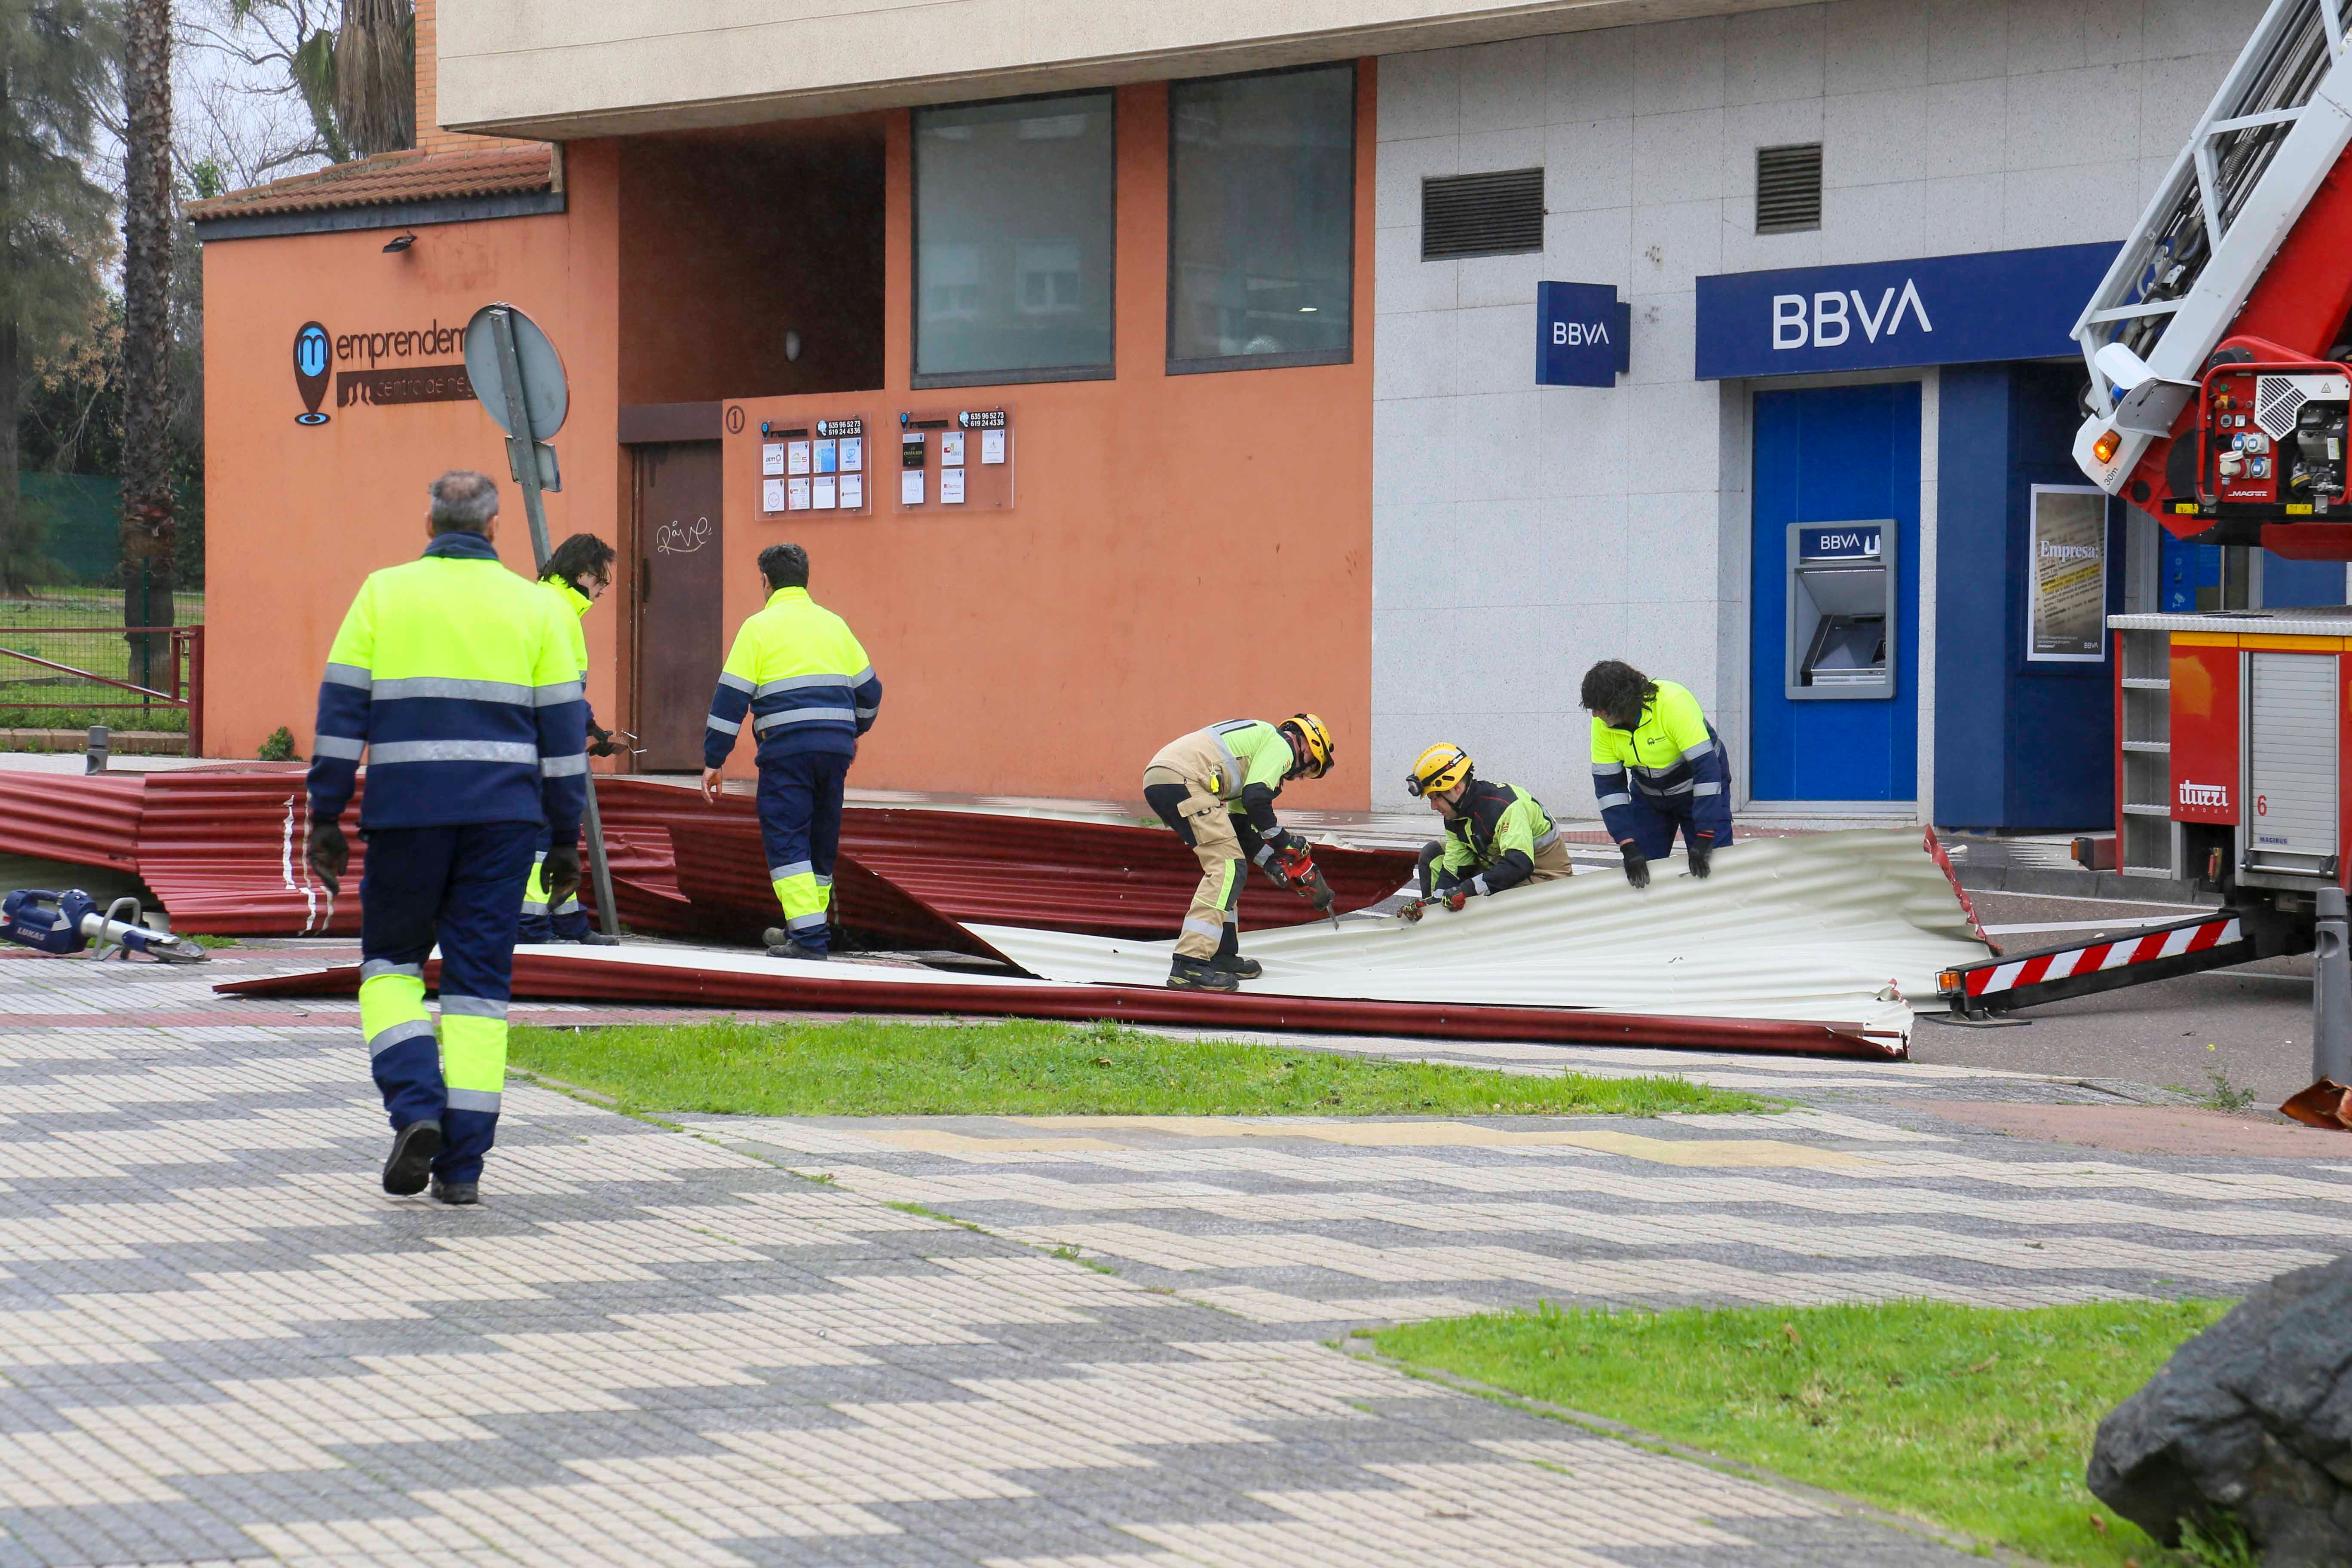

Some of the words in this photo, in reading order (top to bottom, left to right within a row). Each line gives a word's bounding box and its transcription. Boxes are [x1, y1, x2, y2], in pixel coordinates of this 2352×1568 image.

[1773, 278, 1932, 350] BBVA
[1553, 321, 1609, 346] BBVA
[377, 377, 422, 397] centro
[426, 374, 444, 394] de
[2104, 466, 2119, 486] 30m
[1820, 533, 1860, 550] BBVA
[2040, 540, 2098, 563] Empresa:
[2257, 795, 2267, 816] 6
[2259, 836, 2287, 845] MAGIRUS
[17, 927, 45, 940] LUKAS
